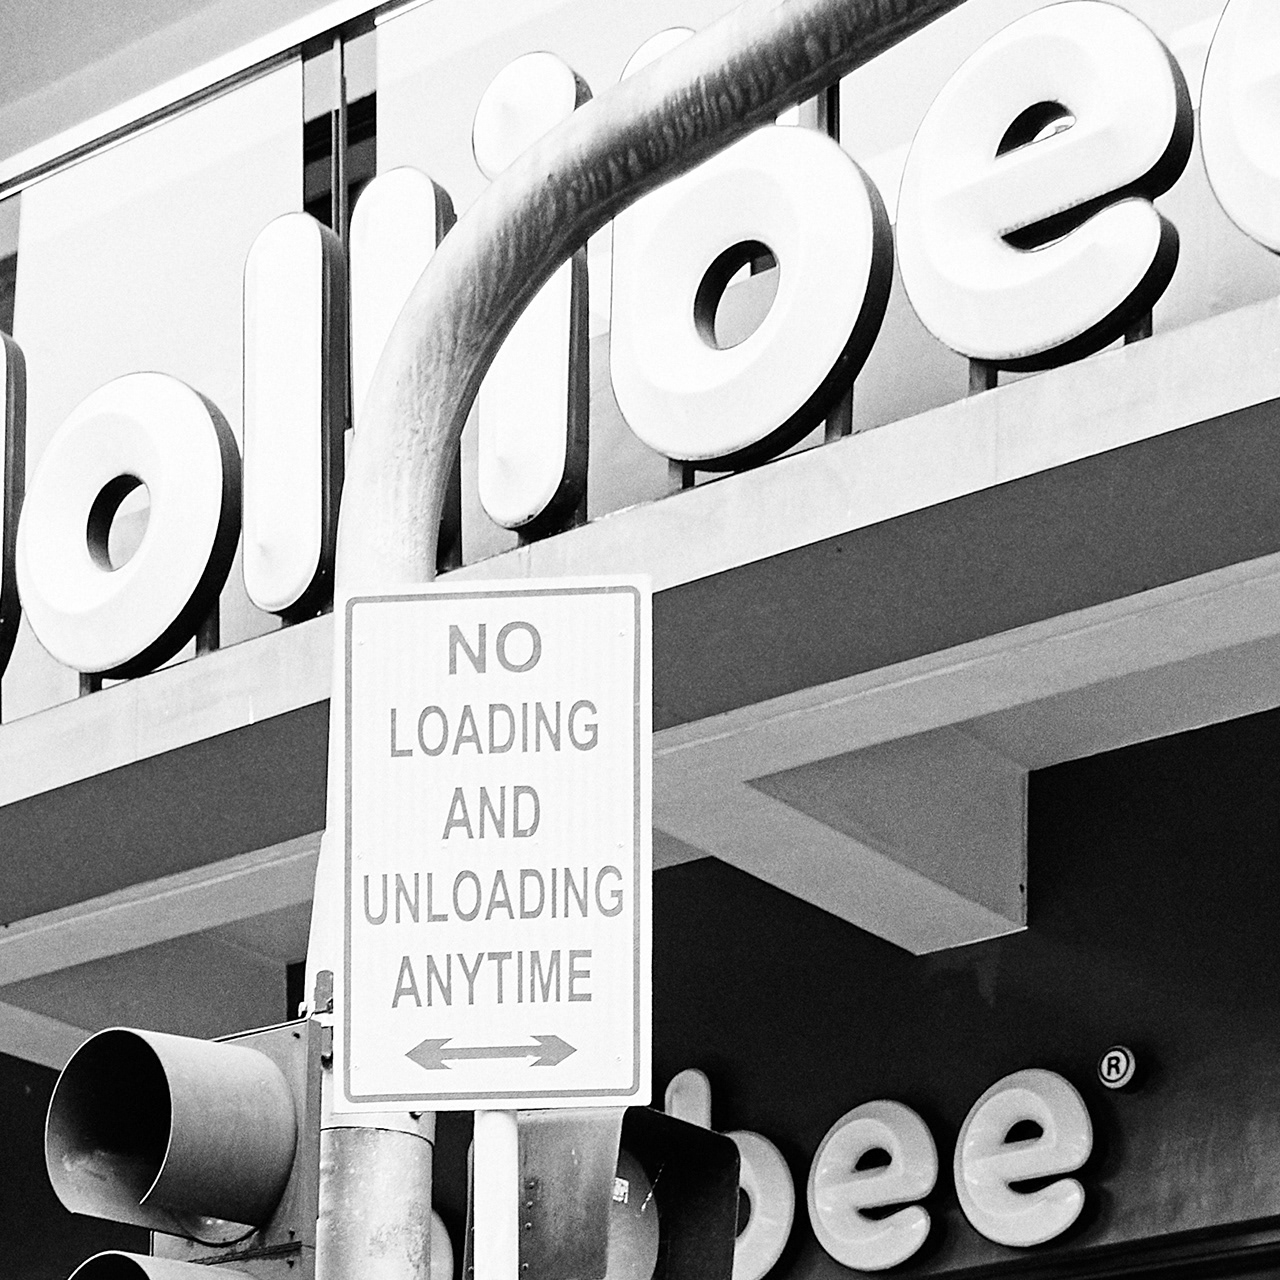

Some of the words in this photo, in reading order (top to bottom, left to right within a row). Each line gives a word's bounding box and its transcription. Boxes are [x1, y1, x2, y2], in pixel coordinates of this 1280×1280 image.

[448, 620, 542, 675] NO
[390, 699, 600, 758] LOADING
[442, 785, 541, 840] AND
[362, 865, 624, 926] UNLOADING
[391, 948, 593, 1009] ANYTIME
